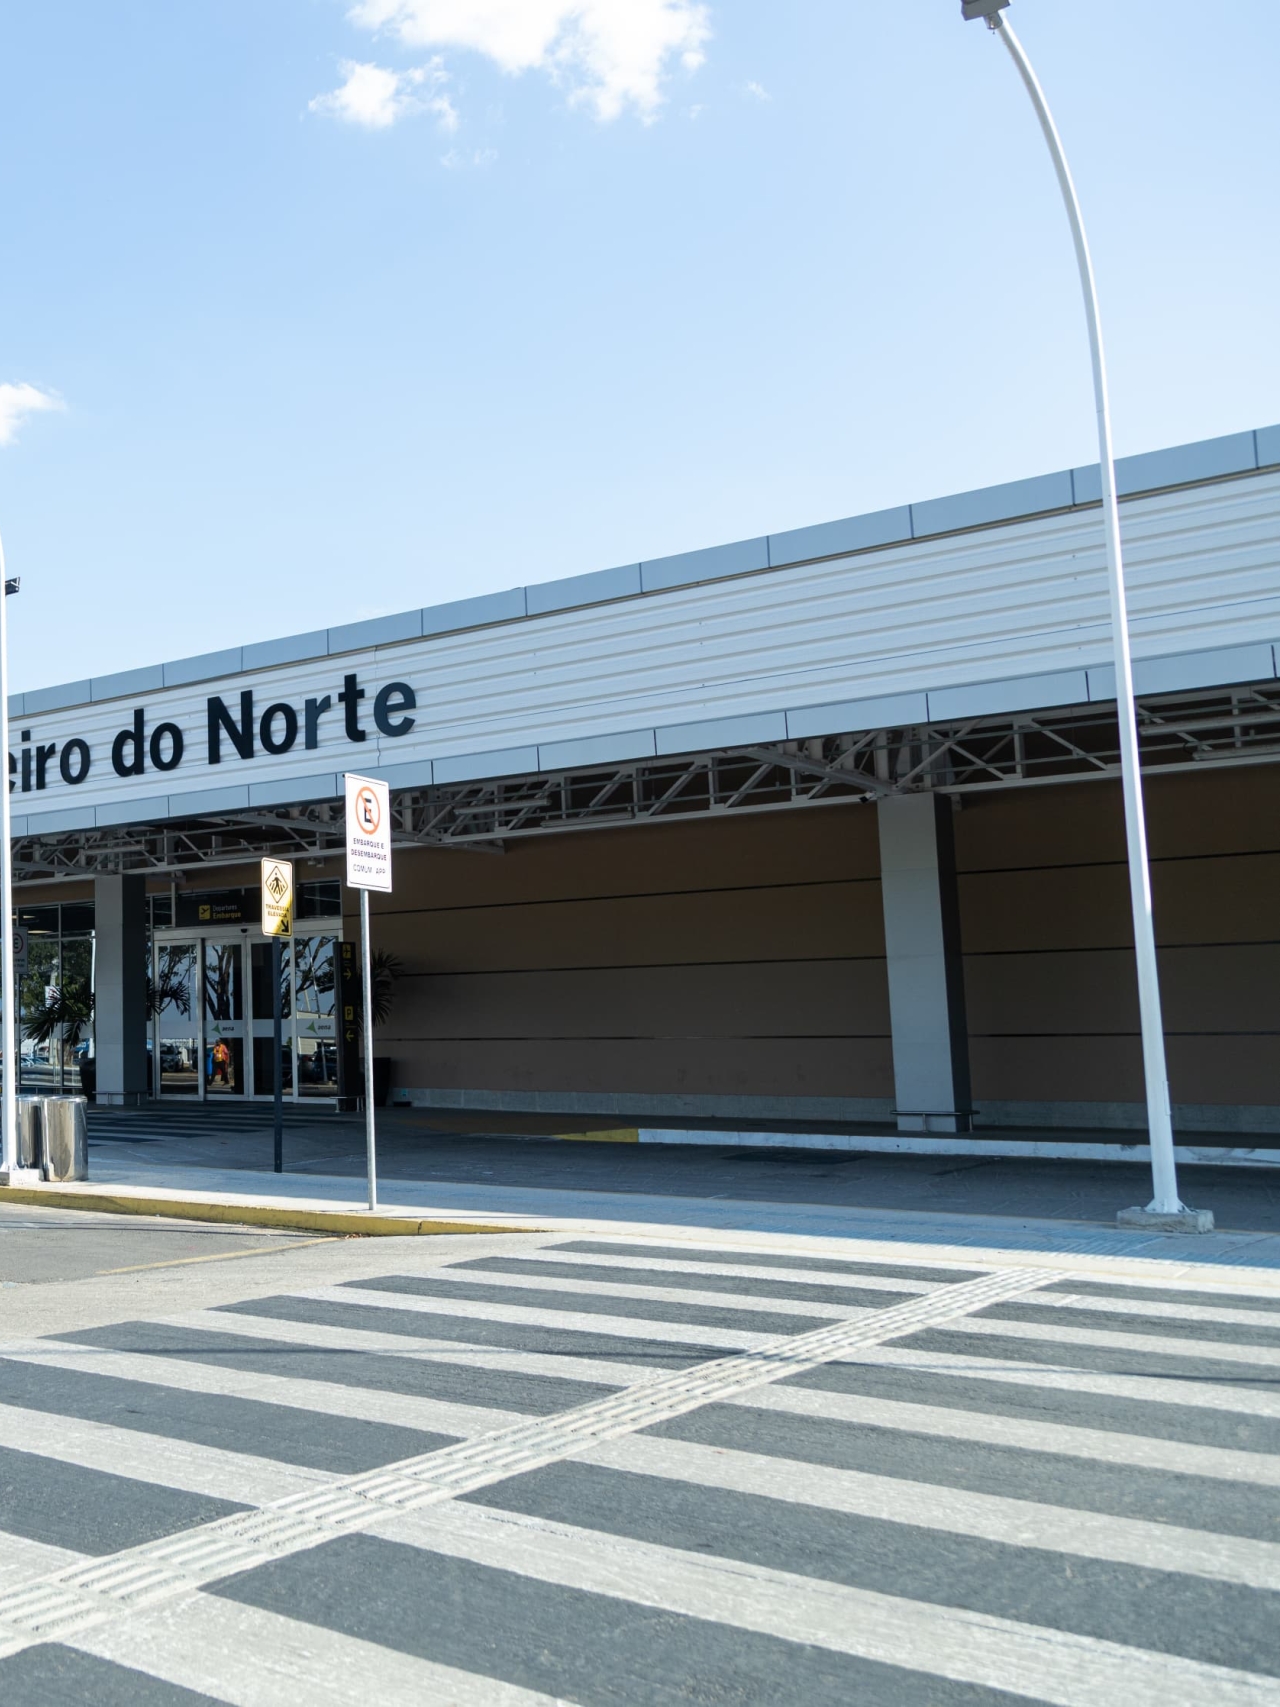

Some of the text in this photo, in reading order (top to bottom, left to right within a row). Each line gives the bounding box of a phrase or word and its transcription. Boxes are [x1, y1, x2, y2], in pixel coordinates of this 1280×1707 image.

[111, 708, 184, 777] do
[207, 673, 417, 765] Norte
[353, 838, 380, 849] EMBARQUE
[351, 848, 387, 861] DESEMBARQUE
